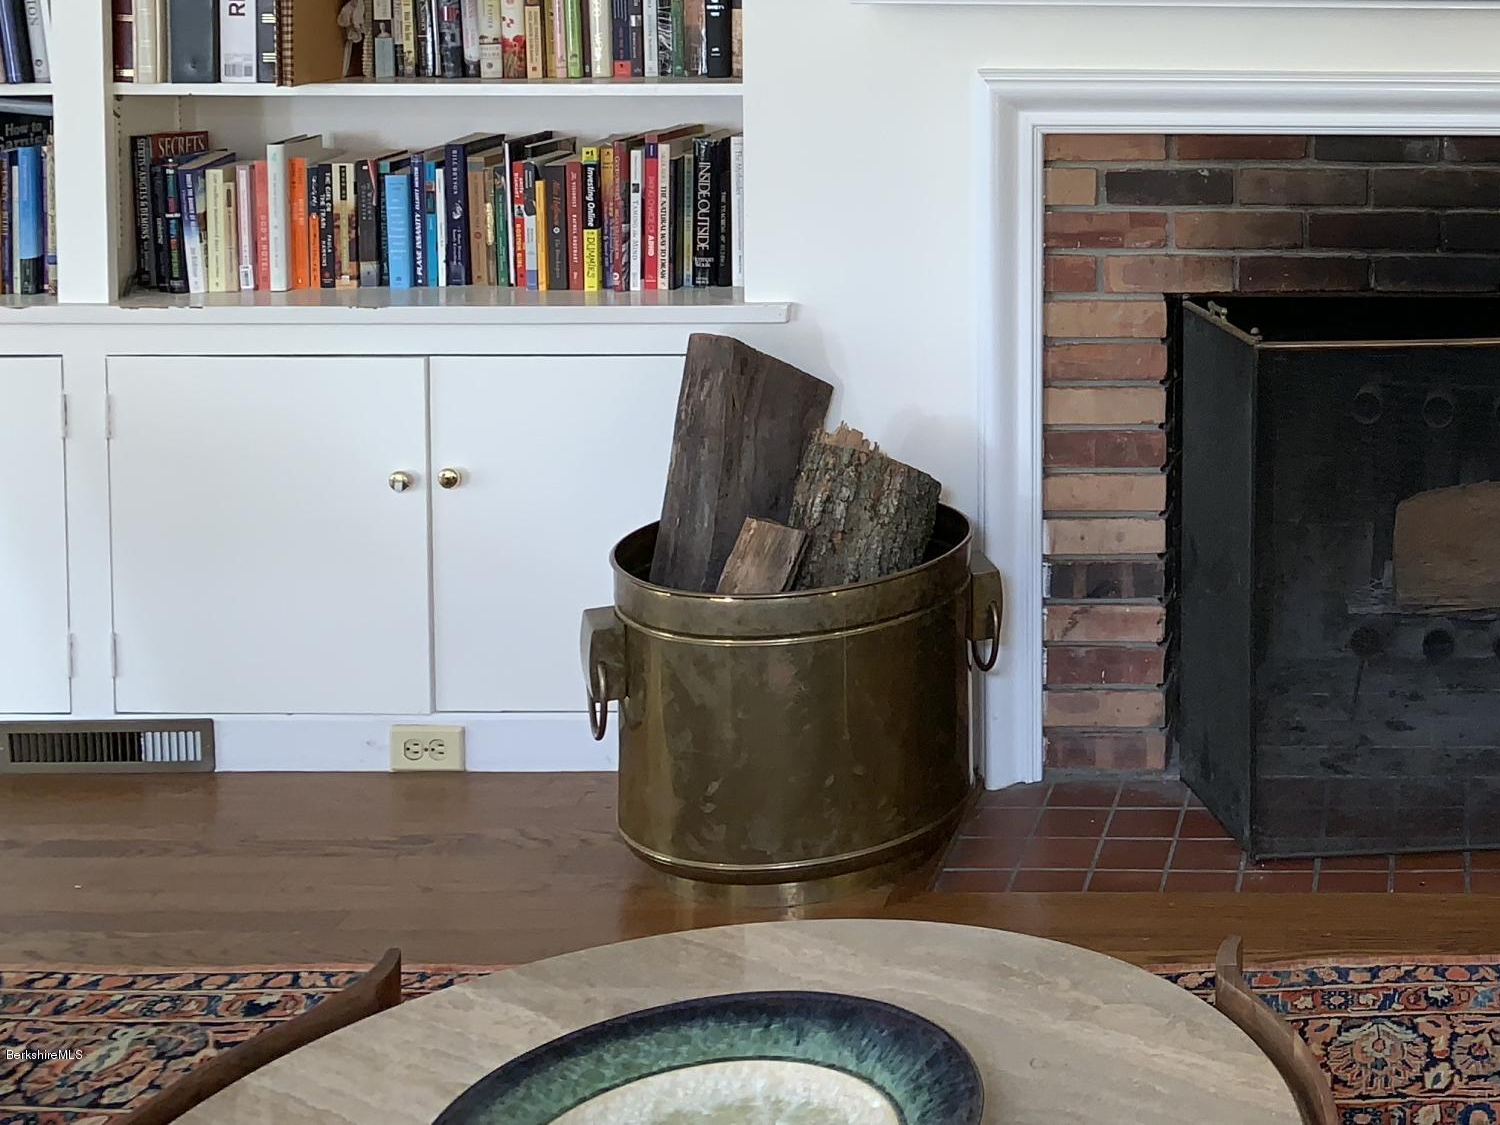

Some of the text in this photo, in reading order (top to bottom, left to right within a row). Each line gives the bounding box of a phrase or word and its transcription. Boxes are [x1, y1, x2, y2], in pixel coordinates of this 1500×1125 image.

[158, 135, 205, 157] SECRETS
[585, 167, 595, 227] Investing Online
